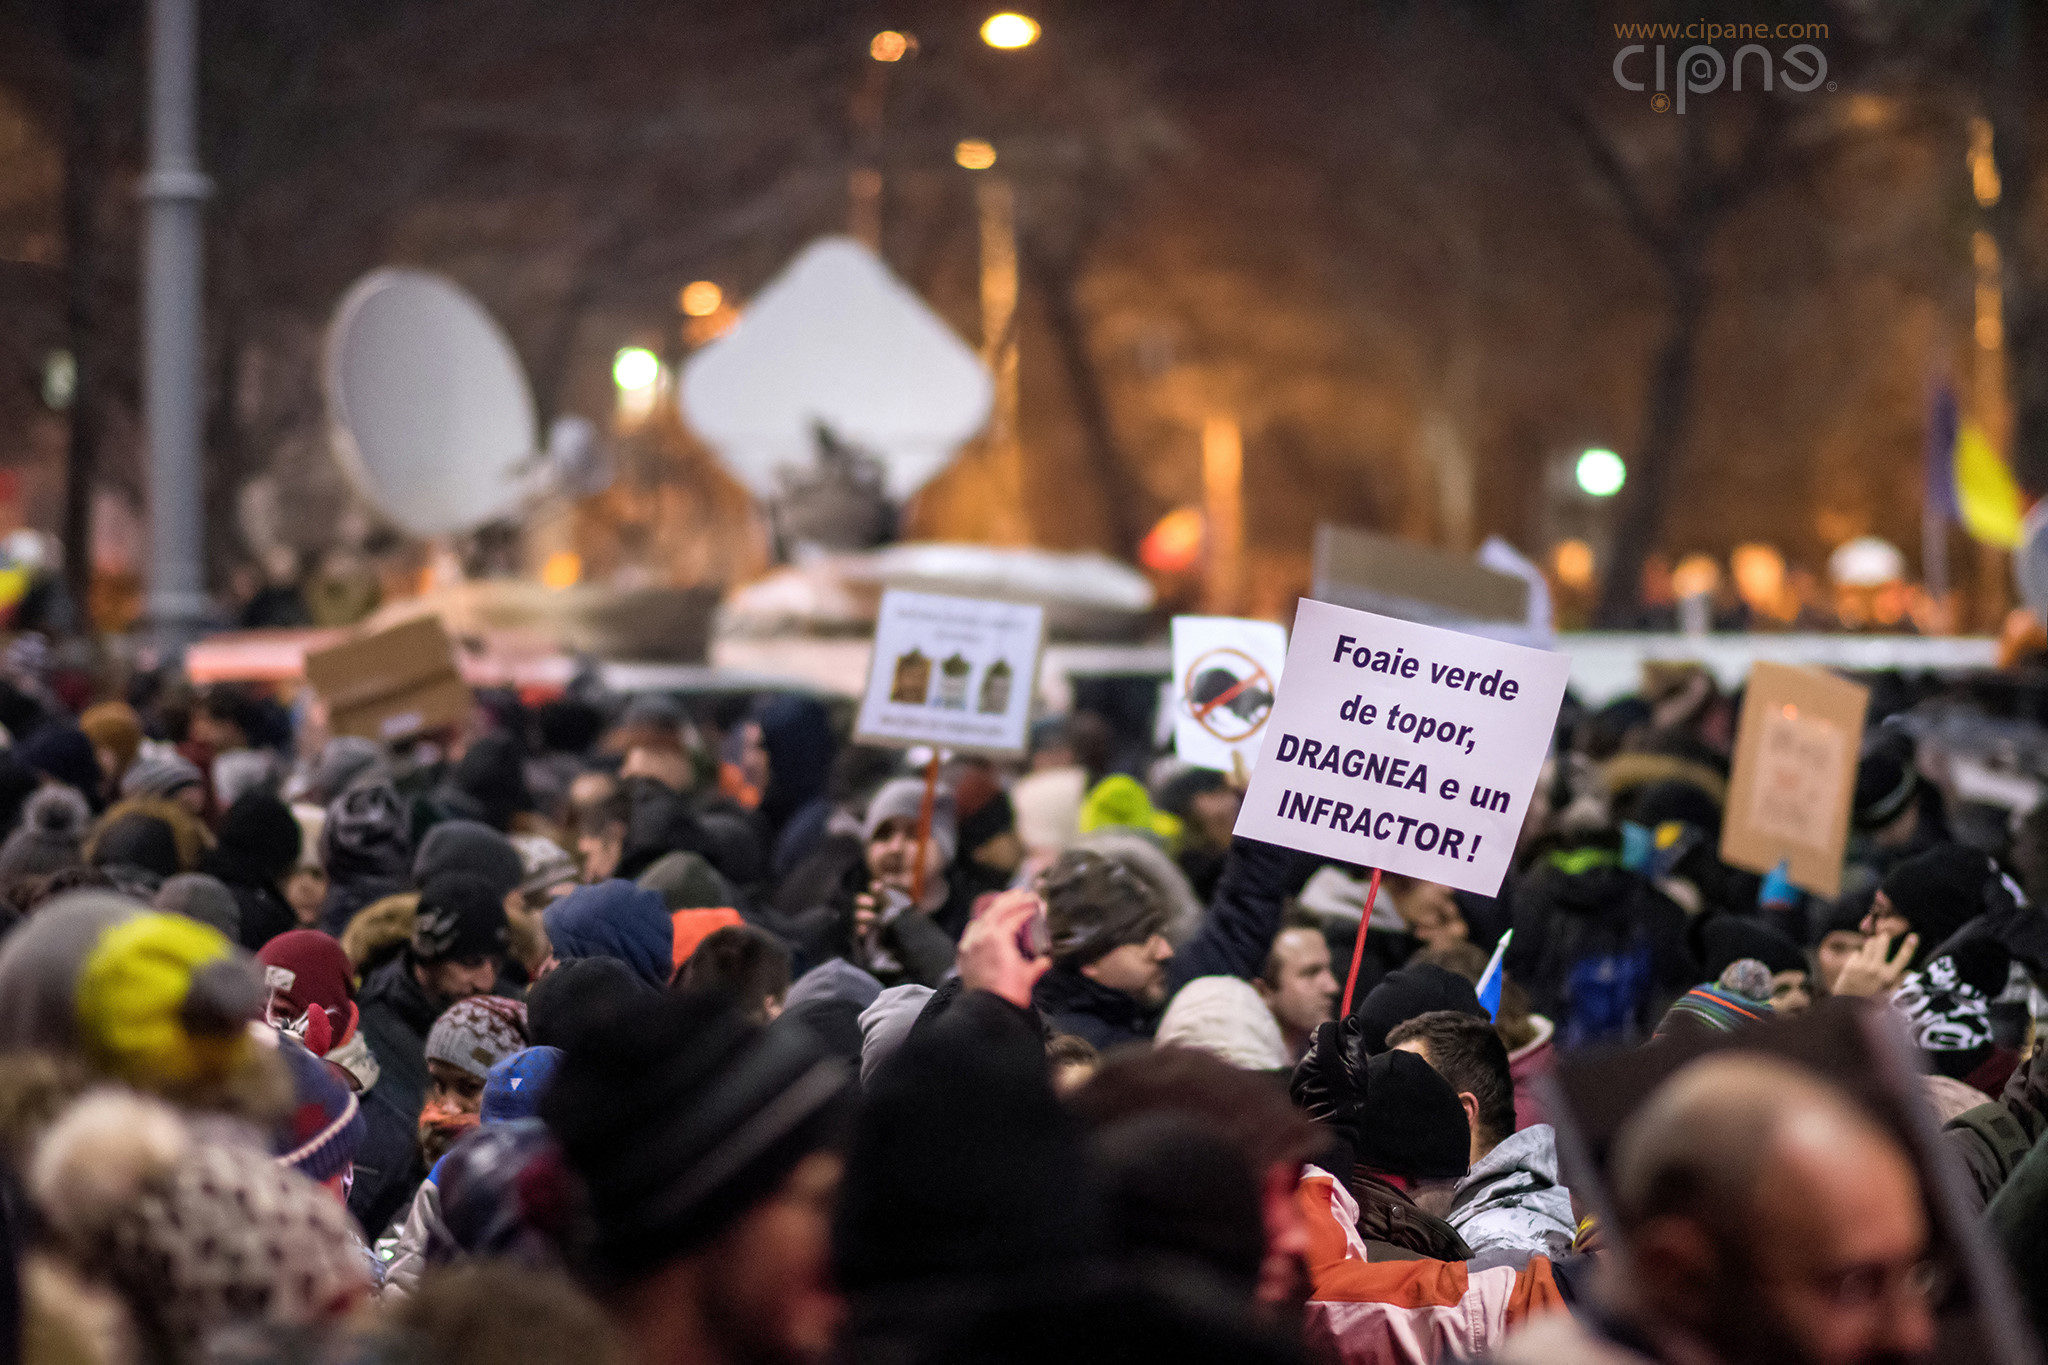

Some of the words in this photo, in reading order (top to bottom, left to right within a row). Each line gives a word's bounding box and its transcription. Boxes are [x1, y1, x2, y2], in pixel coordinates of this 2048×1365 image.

[1333, 635, 1420, 679] Foaie
[1431, 662, 1520, 701] verde
[1340, 695, 1378, 726] de
[1386, 703, 1477, 755] topor,
[1276, 734, 1428, 795] DRAGNEA
[1439, 778, 1460, 801] e
[1470, 786, 1512, 814] un
